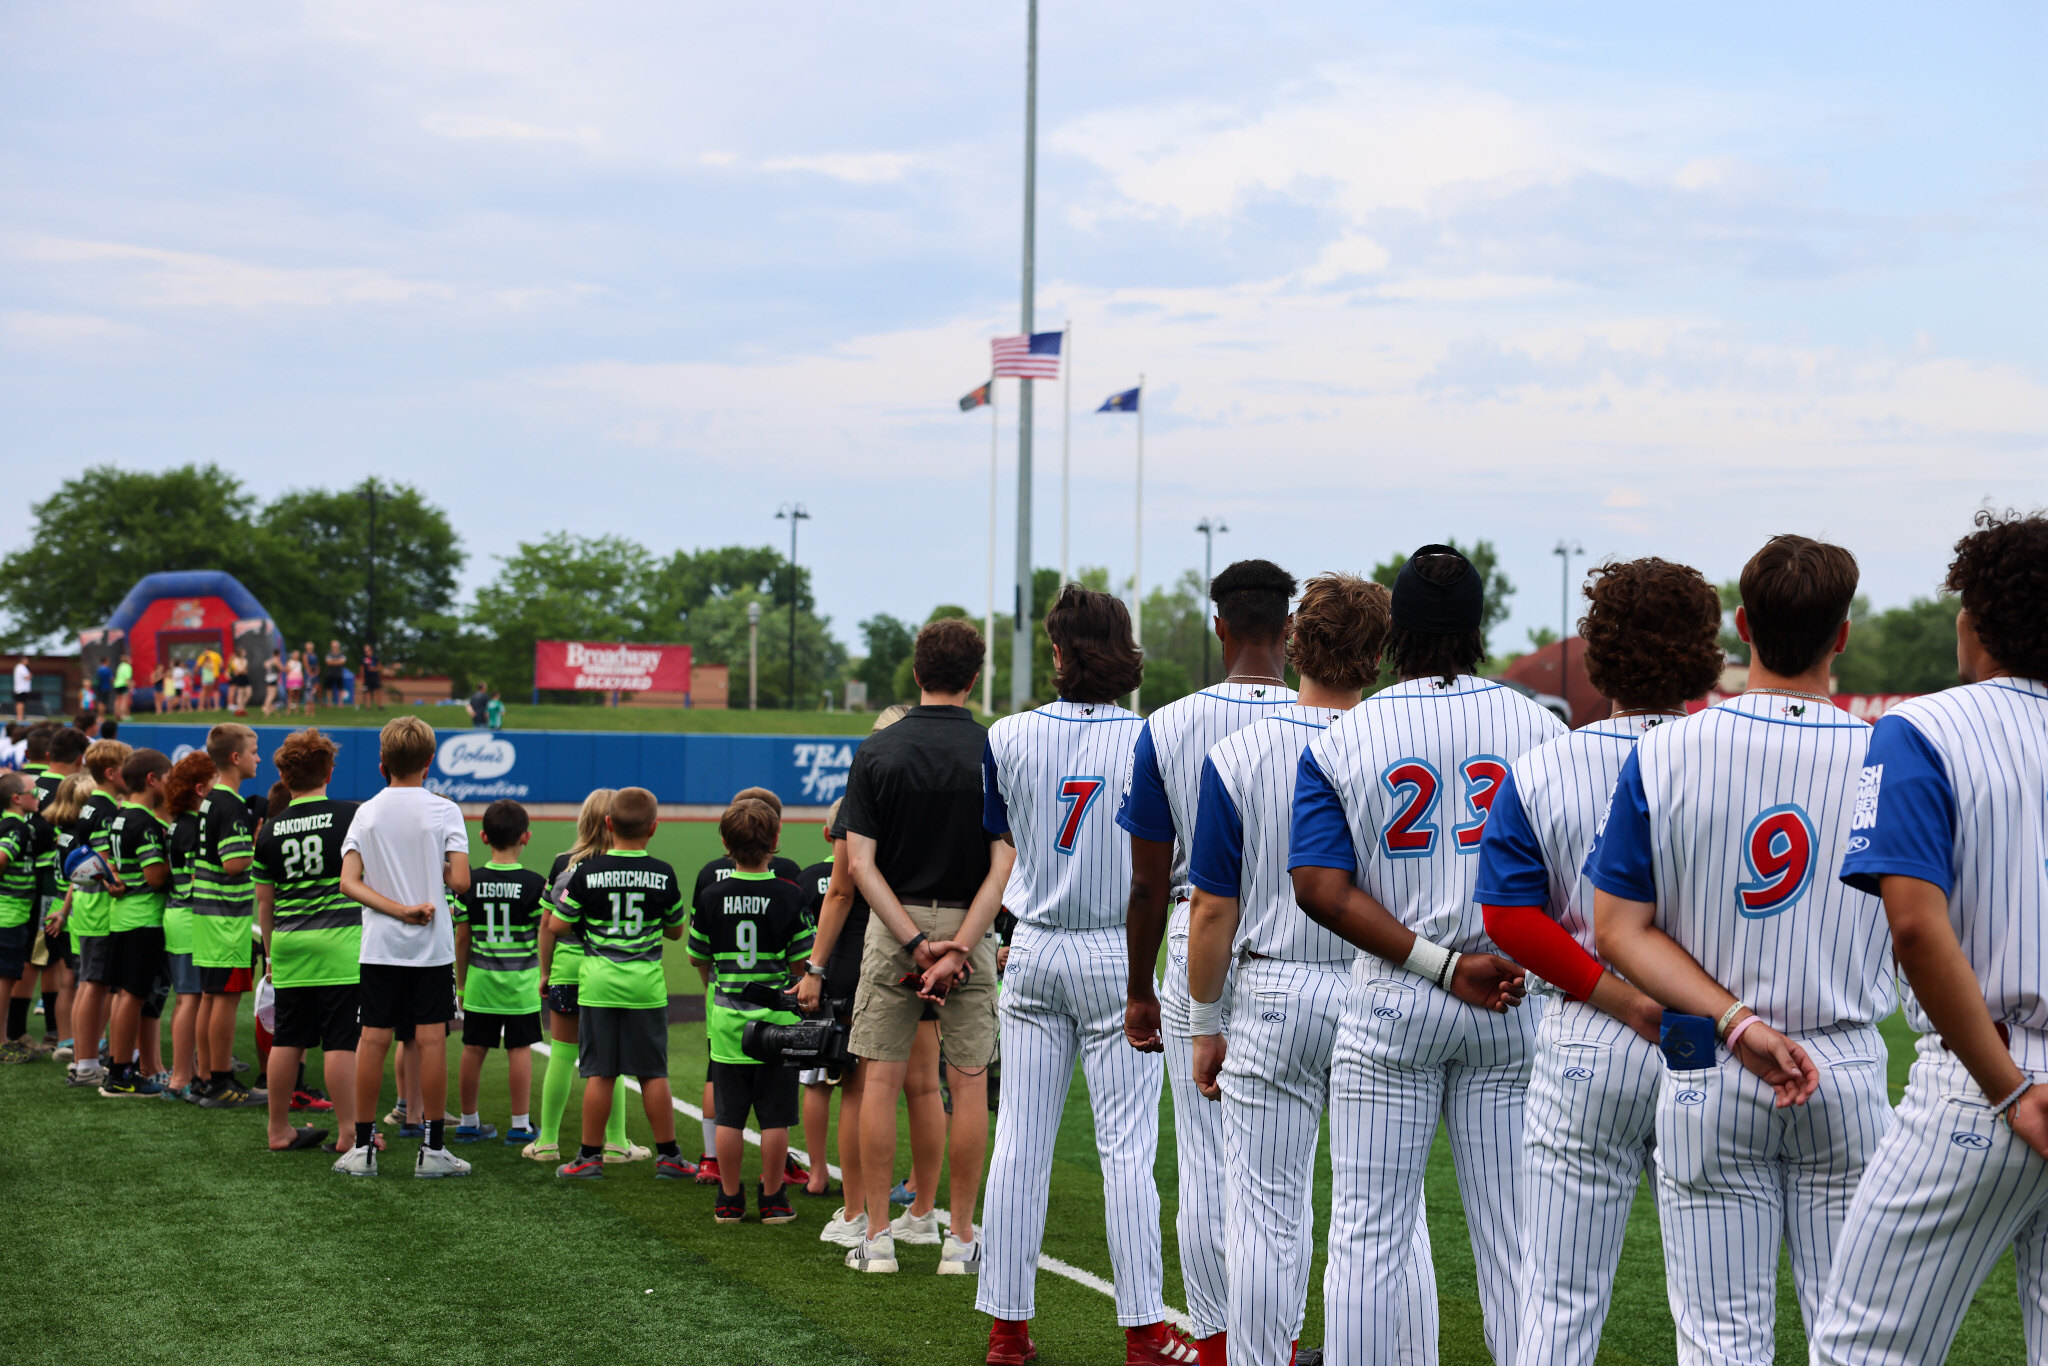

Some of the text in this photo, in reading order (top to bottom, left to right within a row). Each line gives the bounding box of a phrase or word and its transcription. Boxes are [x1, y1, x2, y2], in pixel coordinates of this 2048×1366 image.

[566, 642, 662, 673] Broadway
[574, 674, 653, 690] BACKYARD
[793, 743, 853, 768] TEA
[1053, 775, 1106, 857] 7
[1380, 753, 1512, 860] 23
[1851, 809, 1878, 831] ON
[273, 813, 333, 837] SAKOWICZ
[281, 834, 324, 879] 28
[1734, 803, 1818, 919] 9
[476, 881, 522, 899] LISOWE
[723, 896, 770, 915] HARDY
[483, 902, 513, 943] 11
[607, 892, 645, 936] 15
[736, 920, 757, 969] 9
